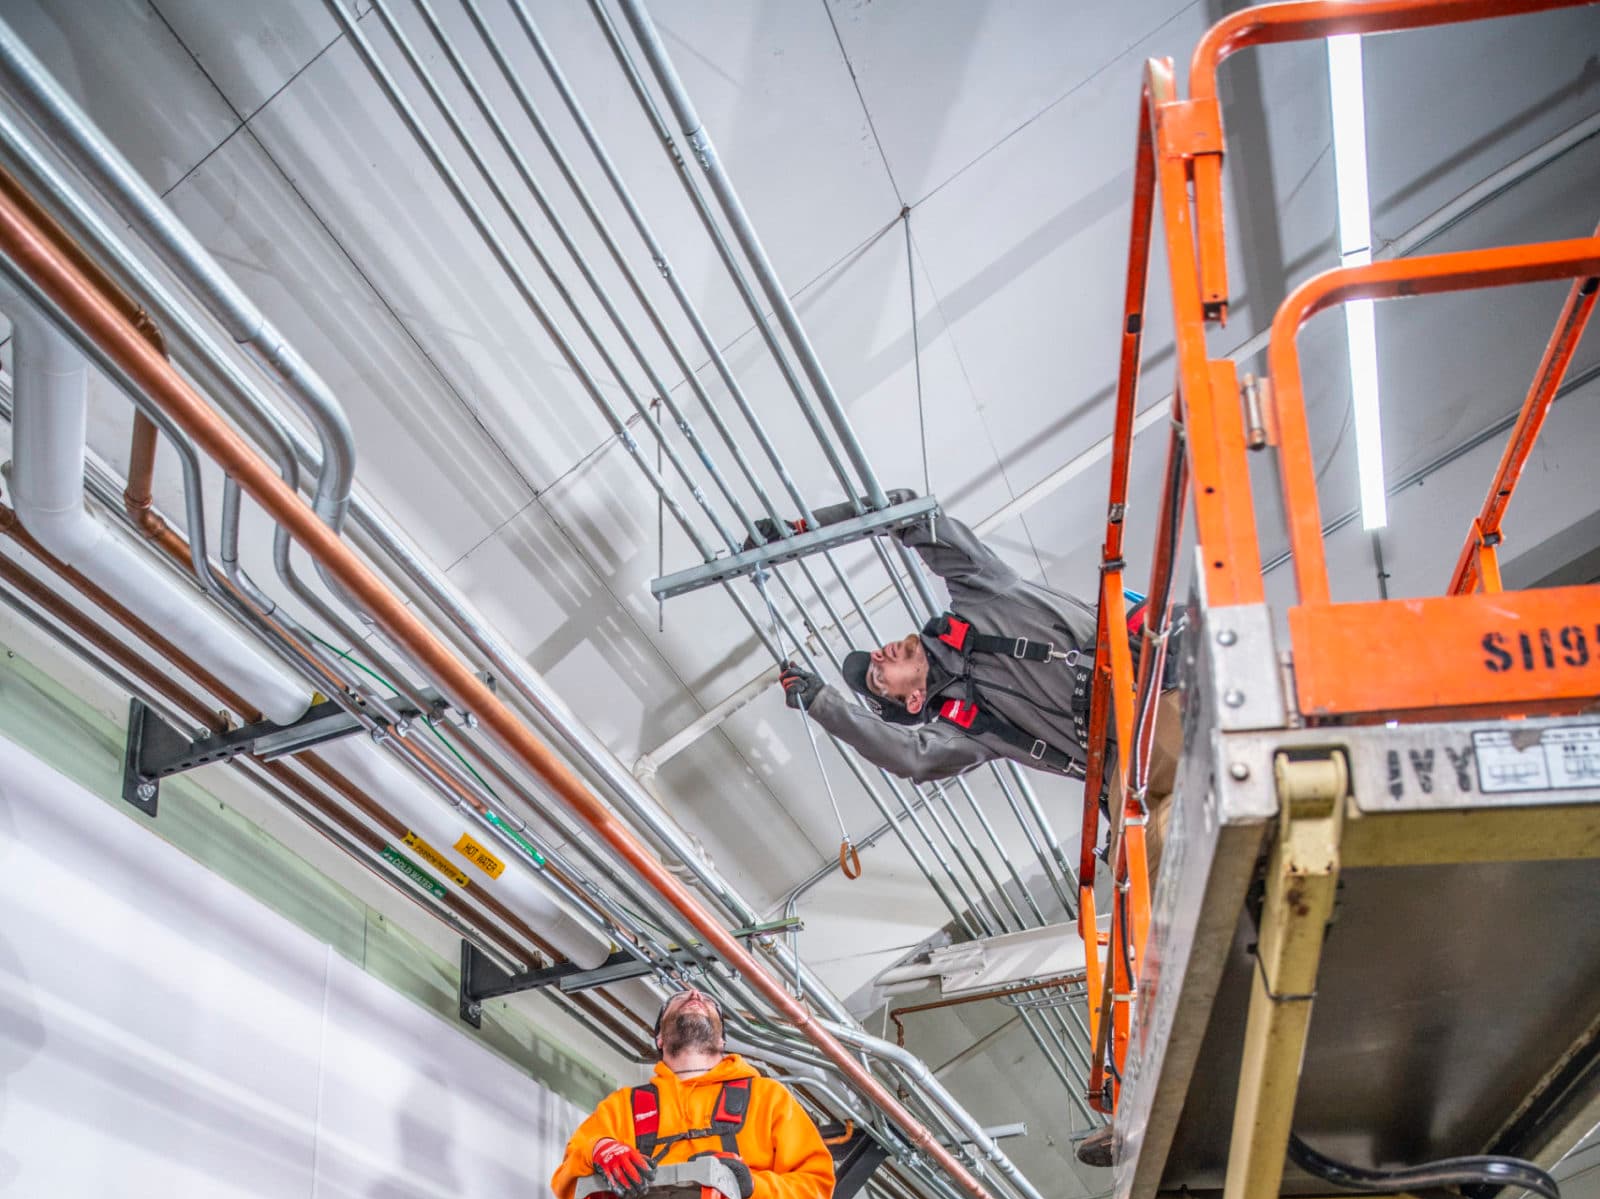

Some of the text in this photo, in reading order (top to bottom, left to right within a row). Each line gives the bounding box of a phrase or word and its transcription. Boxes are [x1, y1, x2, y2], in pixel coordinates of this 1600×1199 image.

[463, 842, 479, 857] HOT
[476, 854, 498, 873] WATER
[393, 858, 434, 890] COLD WATER
